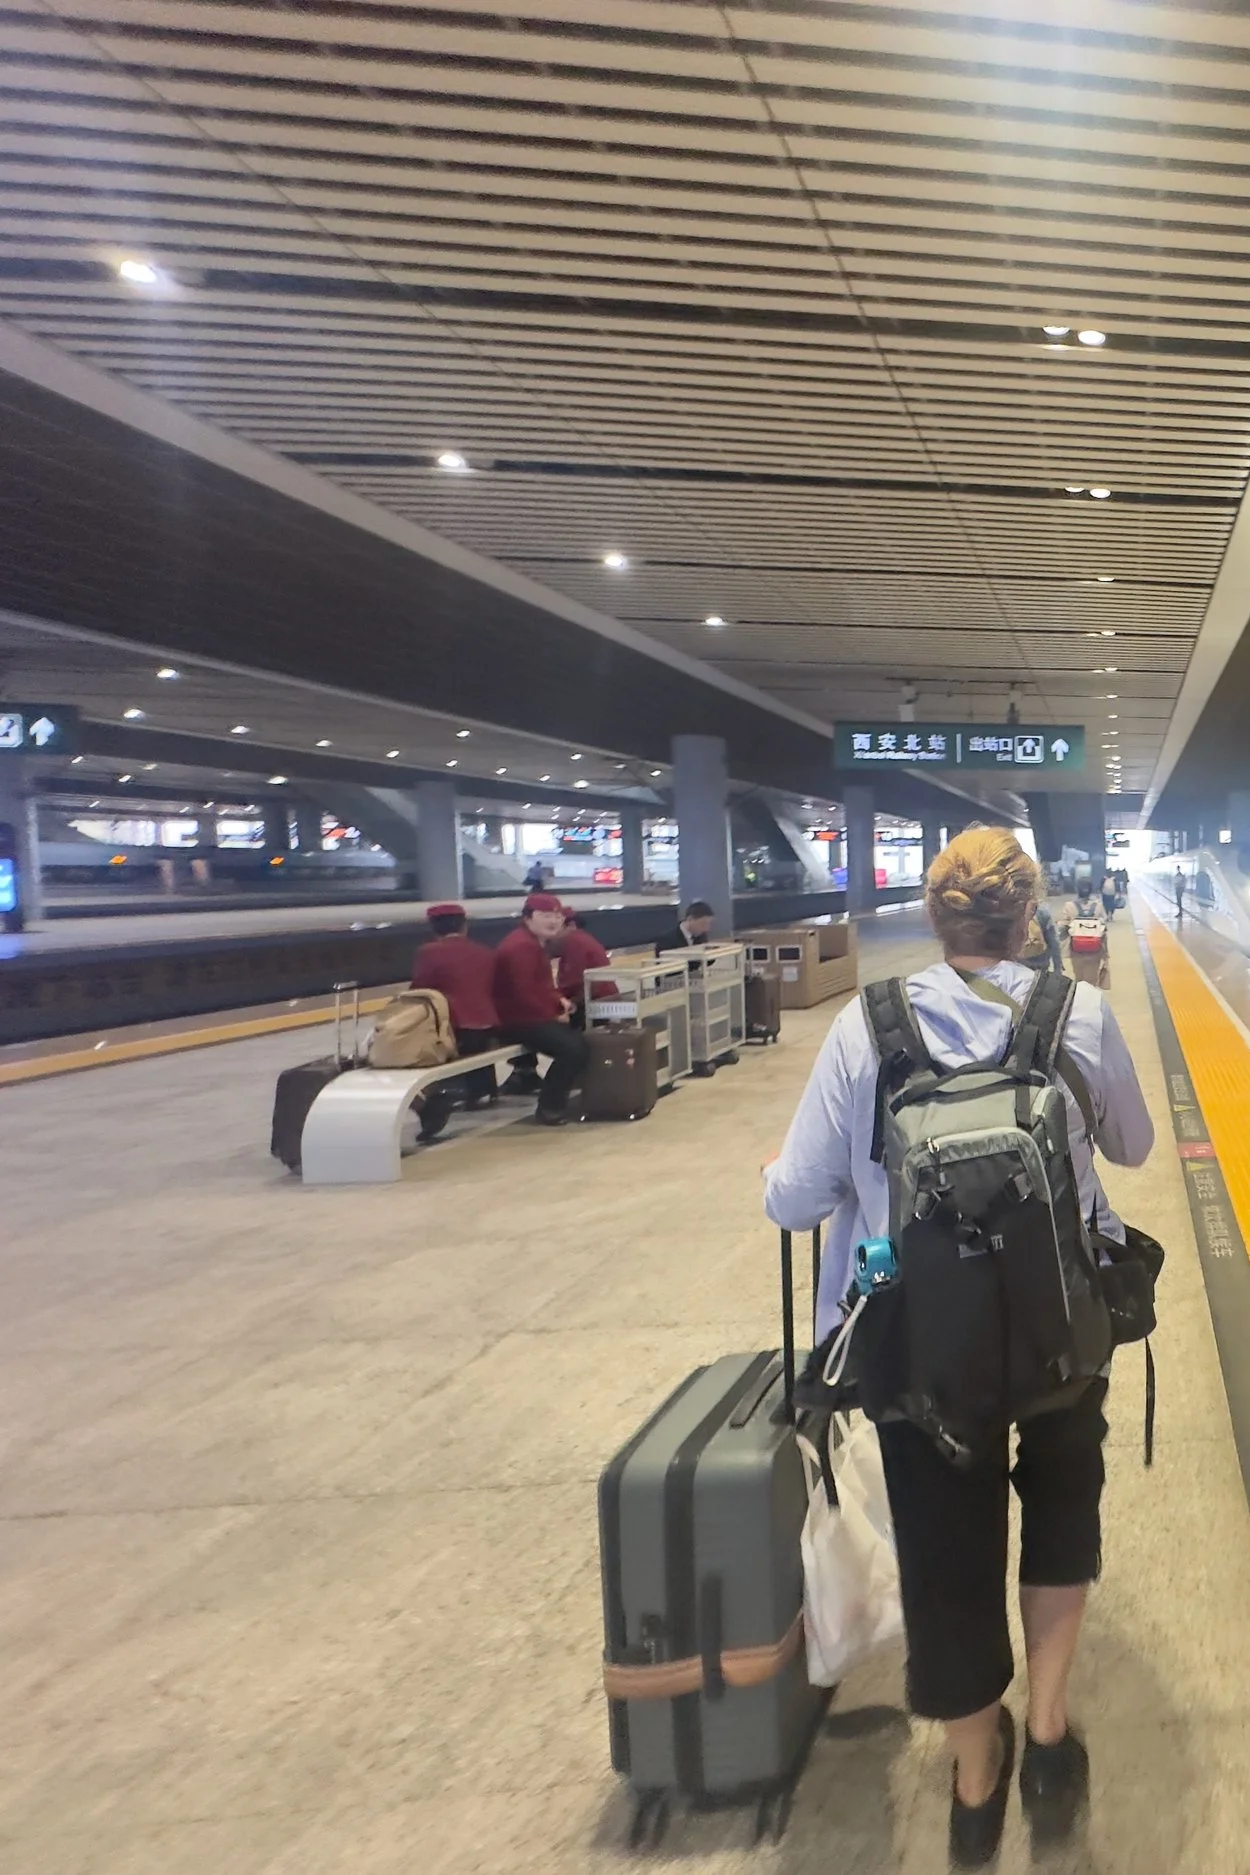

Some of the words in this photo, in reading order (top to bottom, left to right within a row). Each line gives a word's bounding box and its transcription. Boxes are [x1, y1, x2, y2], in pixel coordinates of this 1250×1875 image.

[852, 733, 947, 750] 西安北站
[969, 736, 1013, 751] 出站口
